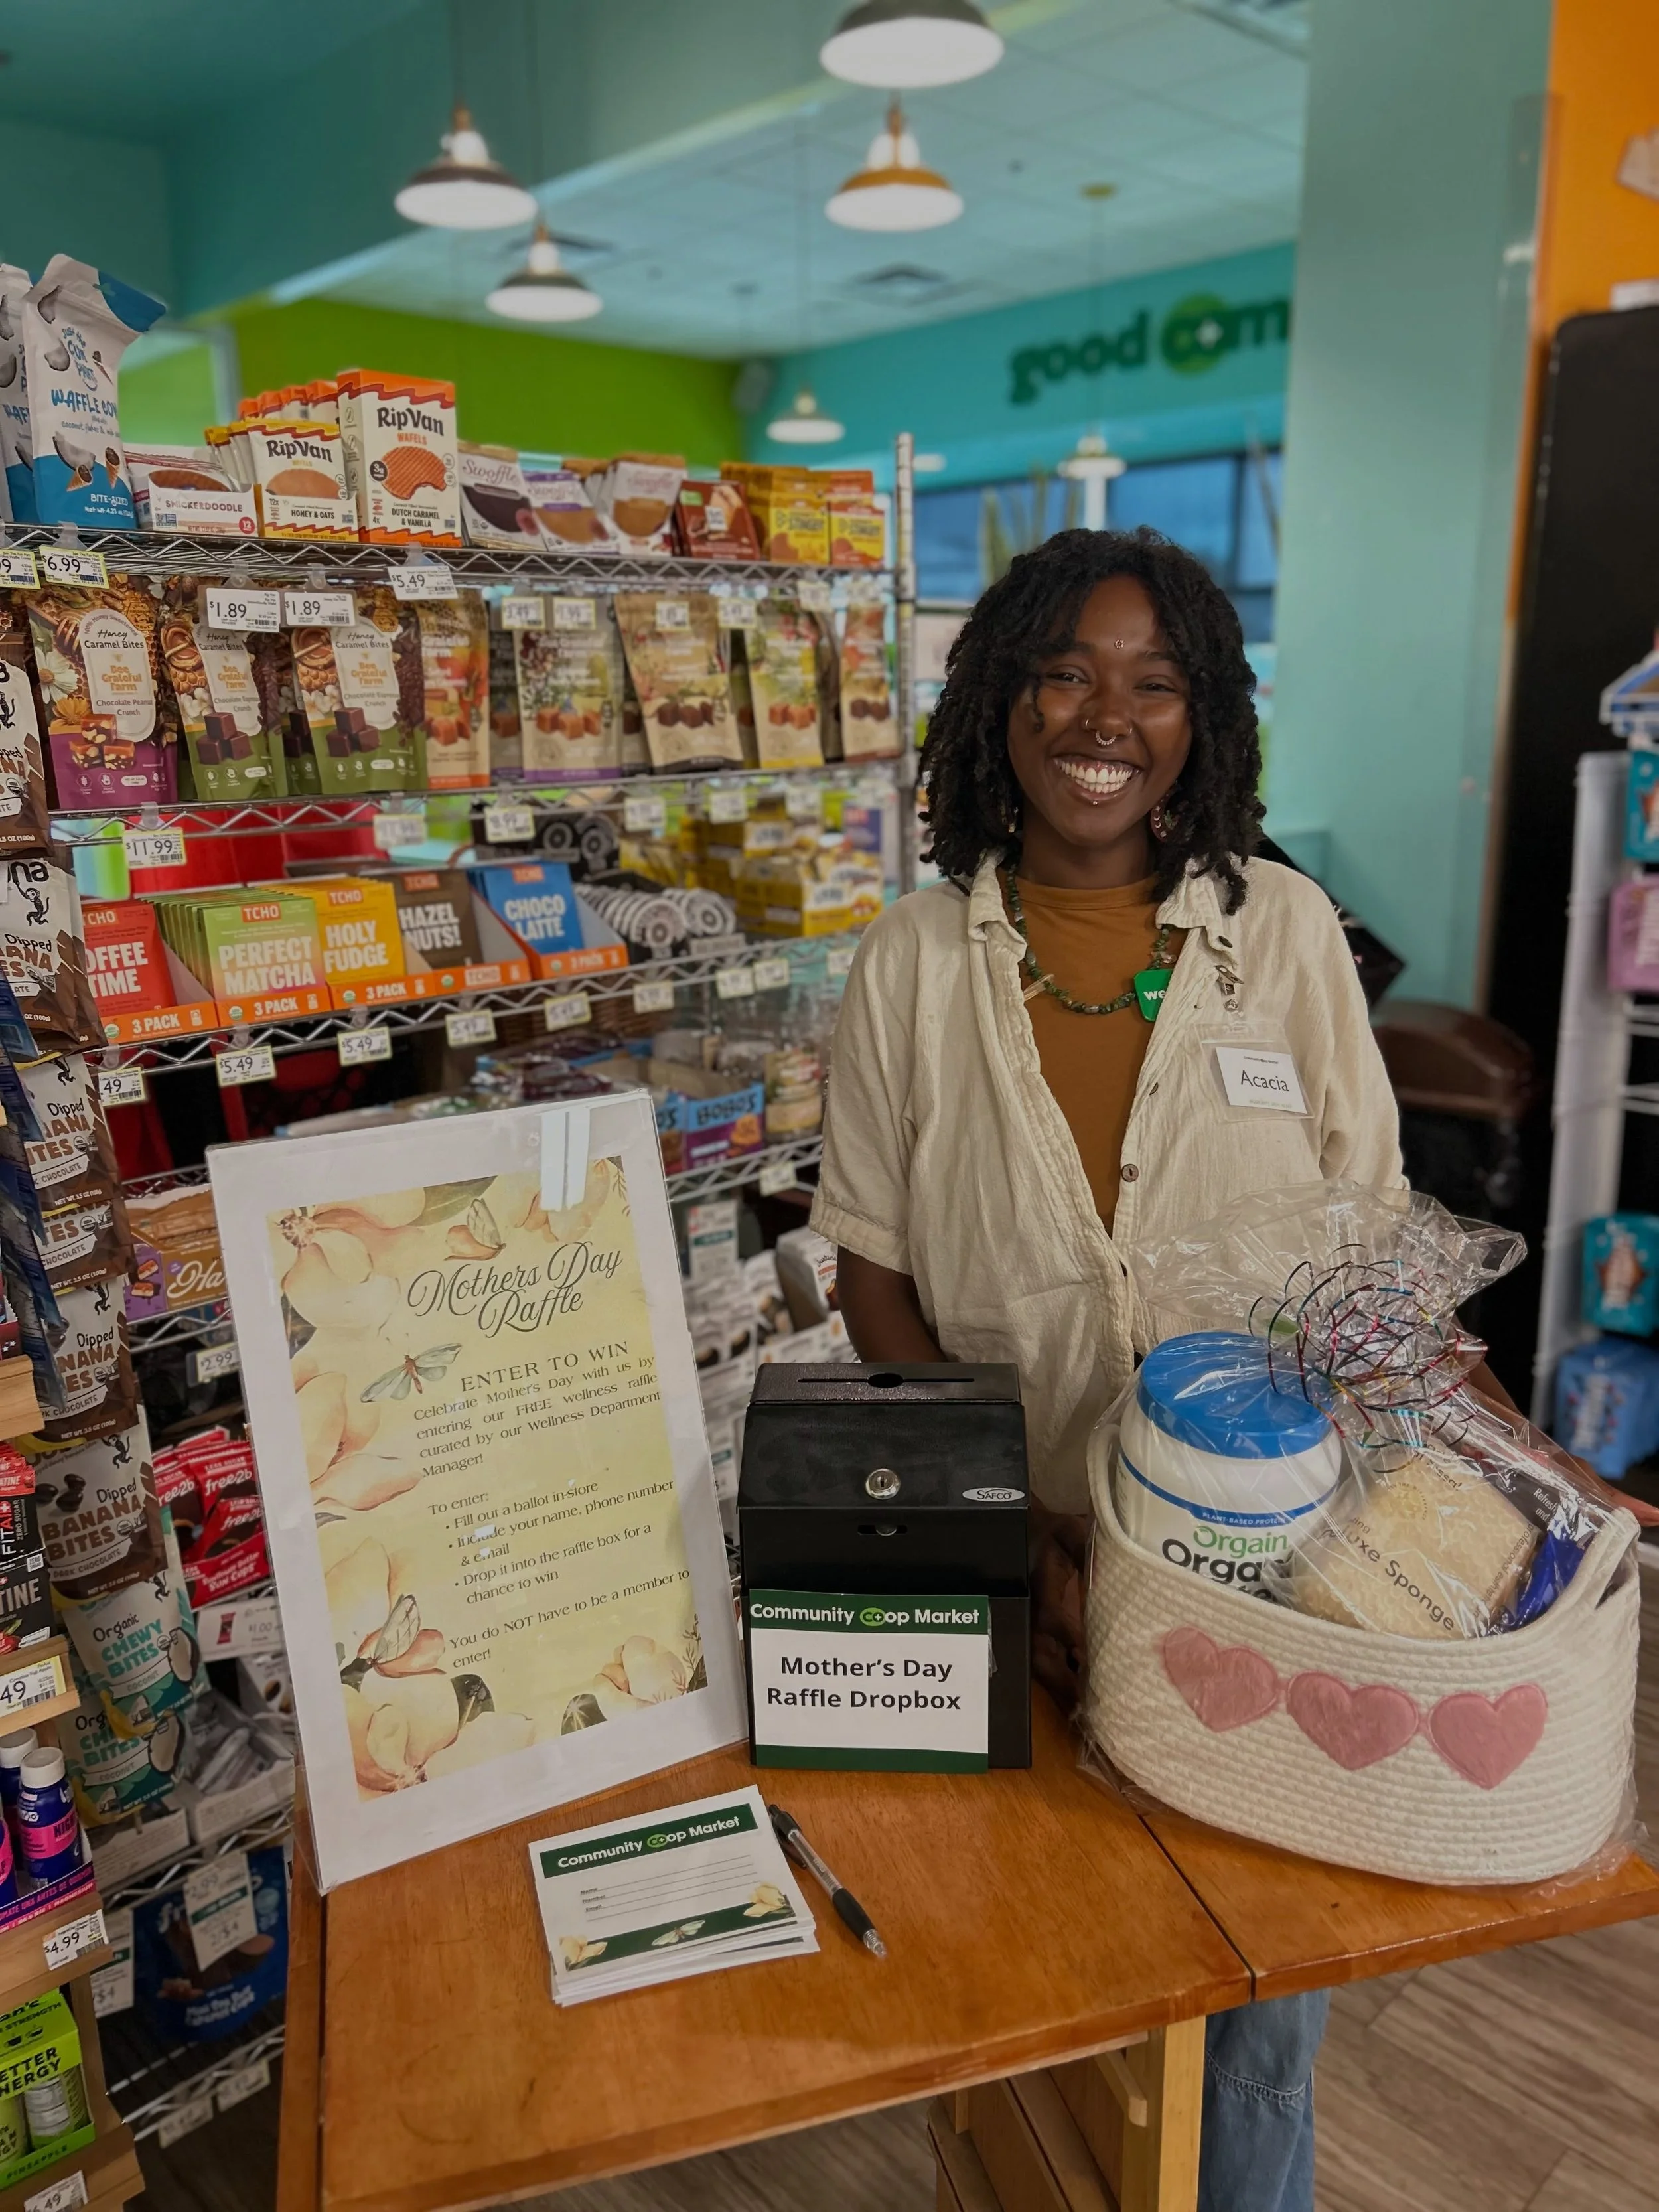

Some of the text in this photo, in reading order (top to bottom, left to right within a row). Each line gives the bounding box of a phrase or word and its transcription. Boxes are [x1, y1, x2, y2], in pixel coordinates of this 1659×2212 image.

[1012, 309, 1149, 404] good
[51, 389, 101, 415] WAFFLE
[377, 407, 444, 436] RipVan
[265, 439, 333, 463] RipVan
[397, 433, 427, 445] WAFELS
[90, 494, 129, 506] BITE-SIZED
[166, 500, 242, 512] SNICKERDOODLE
[291, 509, 312, 518] HONEY
[320, 511, 335, 520] OATS
[392, 508, 440, 520] DUTCH CARAMEL
[407, 519, 431, 528] VANILLA
[42, 554, 81, 573] $6.99
[392, 574, 425, 589] $5.49
[210, 601, 247, 618] $1.89
[285, 600, 321, 616] $1.89
[84, 640, 144, 649] Caramel Bites
[98, 630, 127, 640] Honey
[126, 840, 173, 856] $11.99
[330, 890, 362, 905] TCHO
[504, 894, 565, 921] CHOCO
[244, 905, 279, 920] TCHO
[399, 903, 459, 930] HAZEL
[326, 920, 376, 948] HOLY
[405, 925, 462, 951] NUTS!
[516, 917, 565, 941] LATTE
[5, 932, 52, 952] Dipped
[218, 936, 312, 970] PERFECT
[323, 944, 388, 973] FUDGE
[87, 968, 141, 998] TIME
[224, 962, 316, 995] MATCHA
[366, 982, 407, 1000] 3 PACK
[254, 997, 298, 1016] 3 PACK
[132, 1013, 180, 1034] 3 PACK
[342, 1037, 372, 1053] $5.49
[220, 1057, 253, 1073] $5.49
[1241, 1070, 1289, 1092] Acacia
[47, 1098, 84, 1119] Dipped
[42, 1161, 82, 1183] CHOCOLATE
[407, 1241, 623, 1317] Mothers Day
[478, 1286, 583, 1338] Raffle
[77, 1326, 114, 1349] Dipped
[461, 1341, 629, 1392] ENTER TO WIN
[414, 1355, 654, 1420] Celebrate Mother's Day with us by
[54, 1394, 98, 1416] CHOCOLATE
[417, 1373, 658, 1441] entering our FREE wellness raffle
[419, 1391, 660, 1459] curated by our Wellness Department
[422, 1453, 484, 1479] Manager!
[96, 1477, 137, 1503] Dipped
[977, 1489, 1011, 1500] SAFCO
[429, 1493, 490, 1516] To enter:
[454, 1482, 599, 1529] Fill out a ballot in-store
[509, 1516, 539, 1537] your
[541, 1507, 582, 1526] name,
[585, 1493, 624, 1515] phone
[626, 1479, 674, 1501] number
[1535, 1507, 1550, 1522] and
[41, 1494, 142, 1542] BANANA
[1202, 1512, 1254, 1524] PLANT-BASED
[46, 1525, 115, 1561] BITES
[1193, 1526, 1288, 1558] Orgain
[78, 1548, 121, 1573] CHOCOLATE
[461, 1555, 470, 1567] &
[463, 1524, 652, 1587] Drop it into the raffle box for a
[467, 1570, 559, 1605] chance to win
[1385, 1560, 1455, 1631] Sponge
[449, 1568, 690, 1649] You do NOT have to be a member to
[750, 1603, 855, 1625] Community
[915, 1609, 979, 1625] Market
[93, 1613, 140, 1643] Organic
[101, 1619, 163, 1662] CHEWY
[107, 1647, 159, 1679] BITES
[453, 1648, 491, 1668] enter!
[781, 1656, 953, 1682] Mother’s Day
[127, 1670, 160, 1692] COCONUT
[767, 1688, 962, 1713] Raffle Dropbox
[557, 1838, 643, 1869] Community
[689, 1816, 740, 1838] Market
[44, 1932, 80, 1954] $4.99
